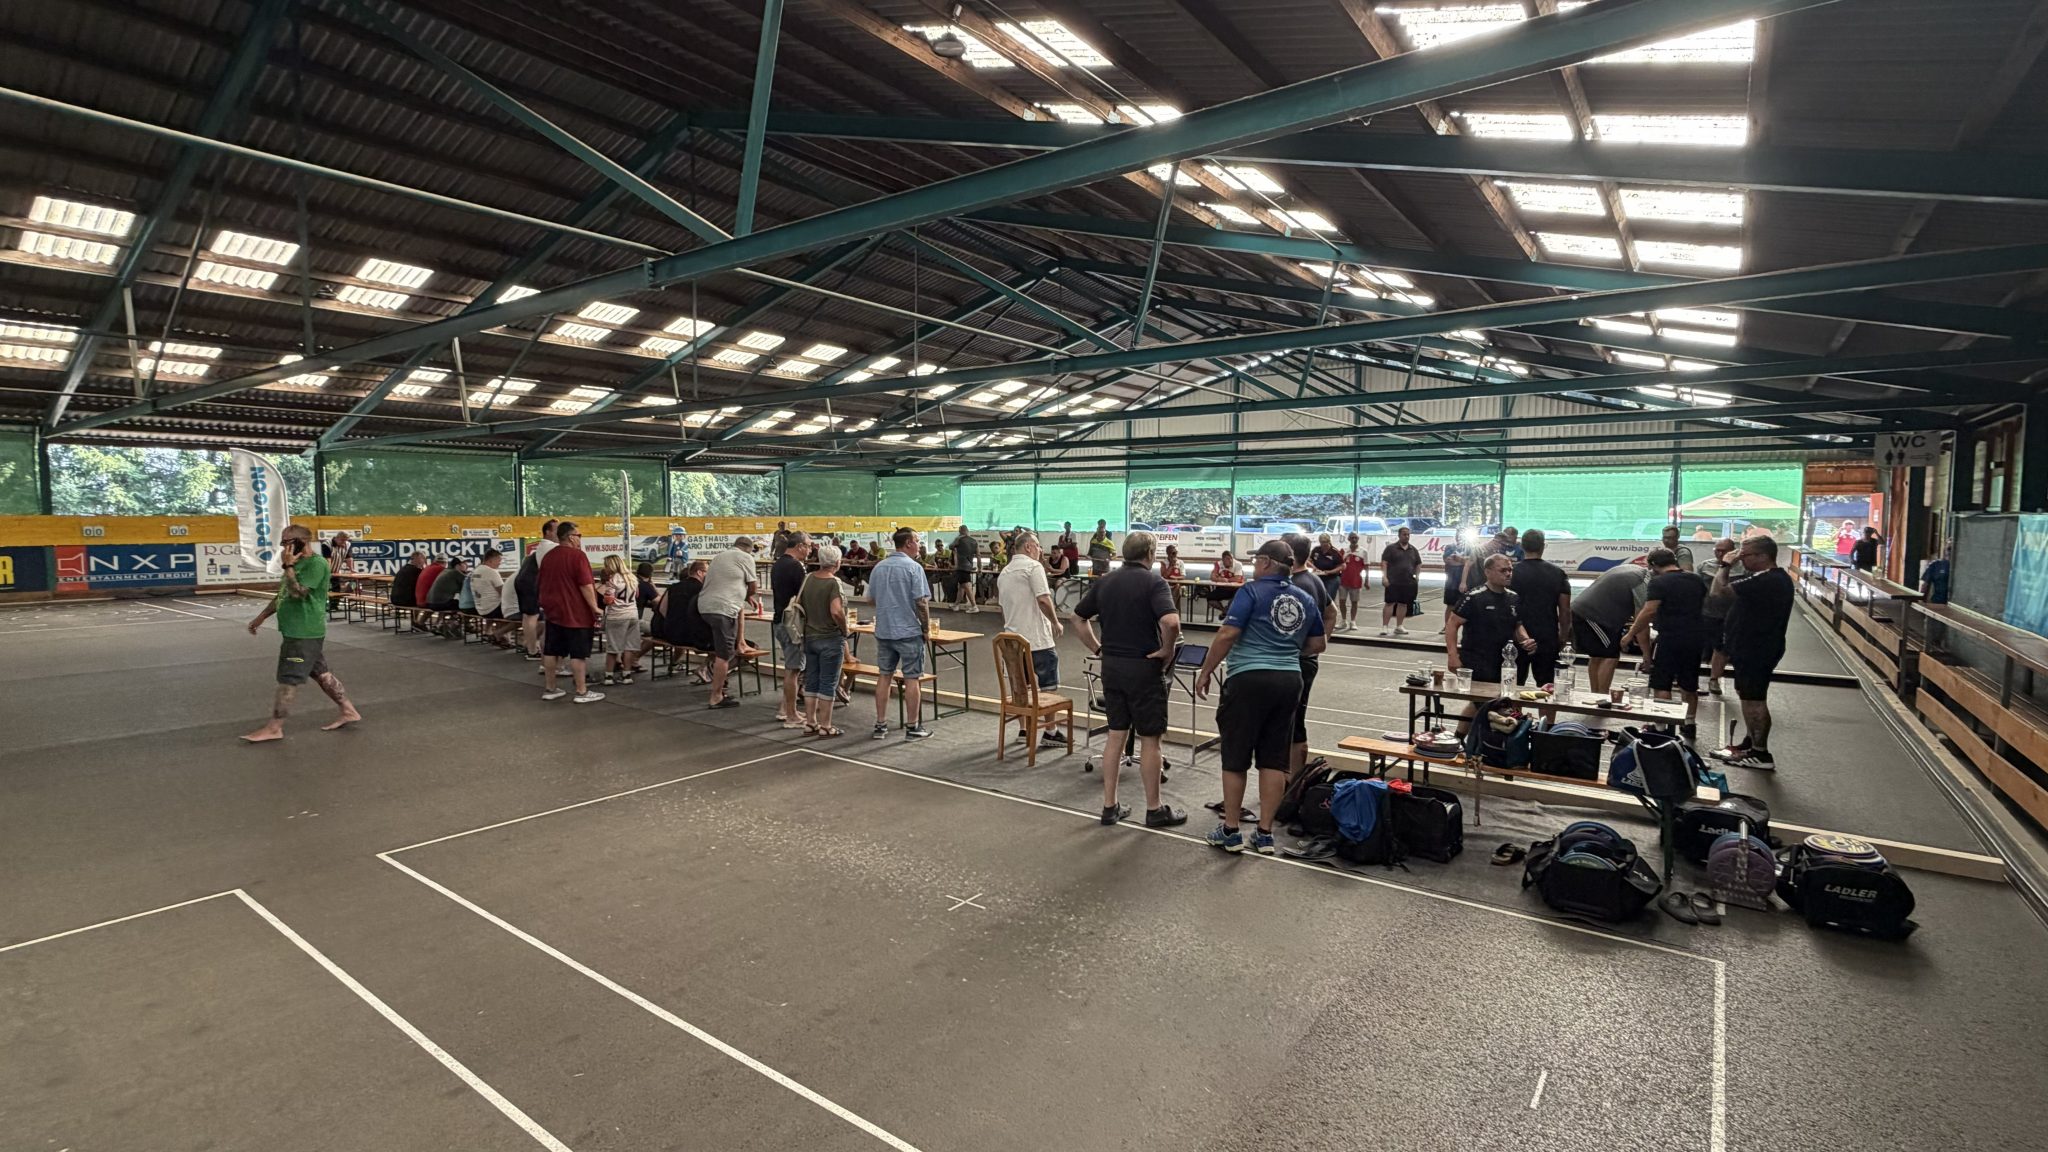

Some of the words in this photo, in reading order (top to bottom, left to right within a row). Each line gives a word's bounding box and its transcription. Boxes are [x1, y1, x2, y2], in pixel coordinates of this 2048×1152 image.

[1890, 435, 1926, 448] WC
[687, 535, 729, 543] GASTHAUS
[398, 541, 489, 558] DRUCKT
[90, 553, 195, 572] NXP
[58, 573, 154, 582] ENTERTAINMENT
[1823, 883, 1878, 898] LADLER
